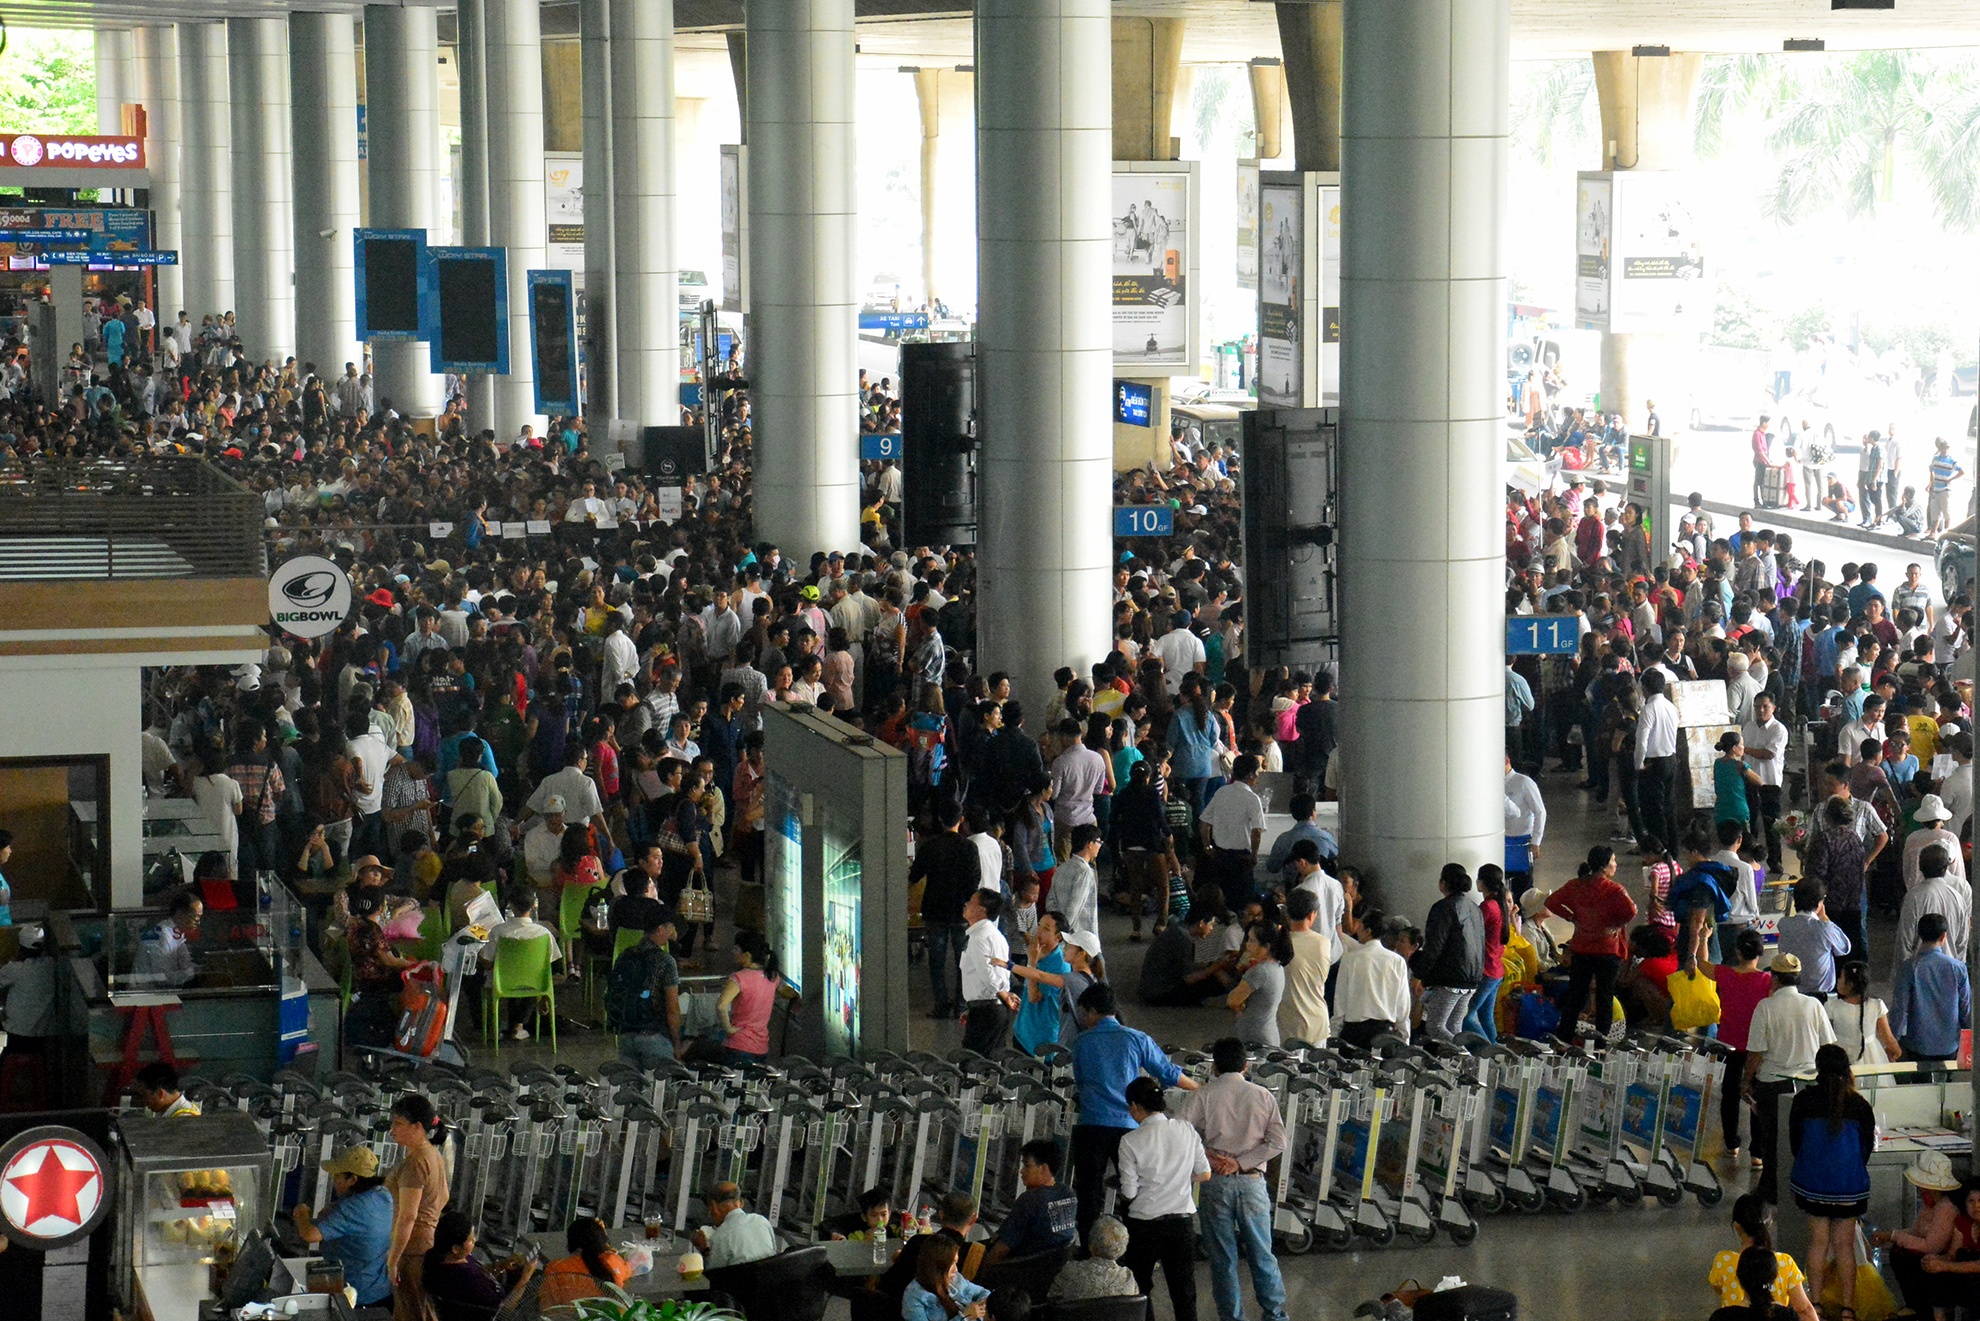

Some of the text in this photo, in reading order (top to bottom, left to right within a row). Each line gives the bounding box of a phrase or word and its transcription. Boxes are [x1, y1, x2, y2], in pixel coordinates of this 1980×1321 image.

[44, 213, 104, 229] FREE
[880, 437, 892, 456] 9
[1129, 510, 1168, 532] 10 GF
[276, 611, 343, 622] BIGBOWL
[1527, 621, 1573, 648] 11 GF
